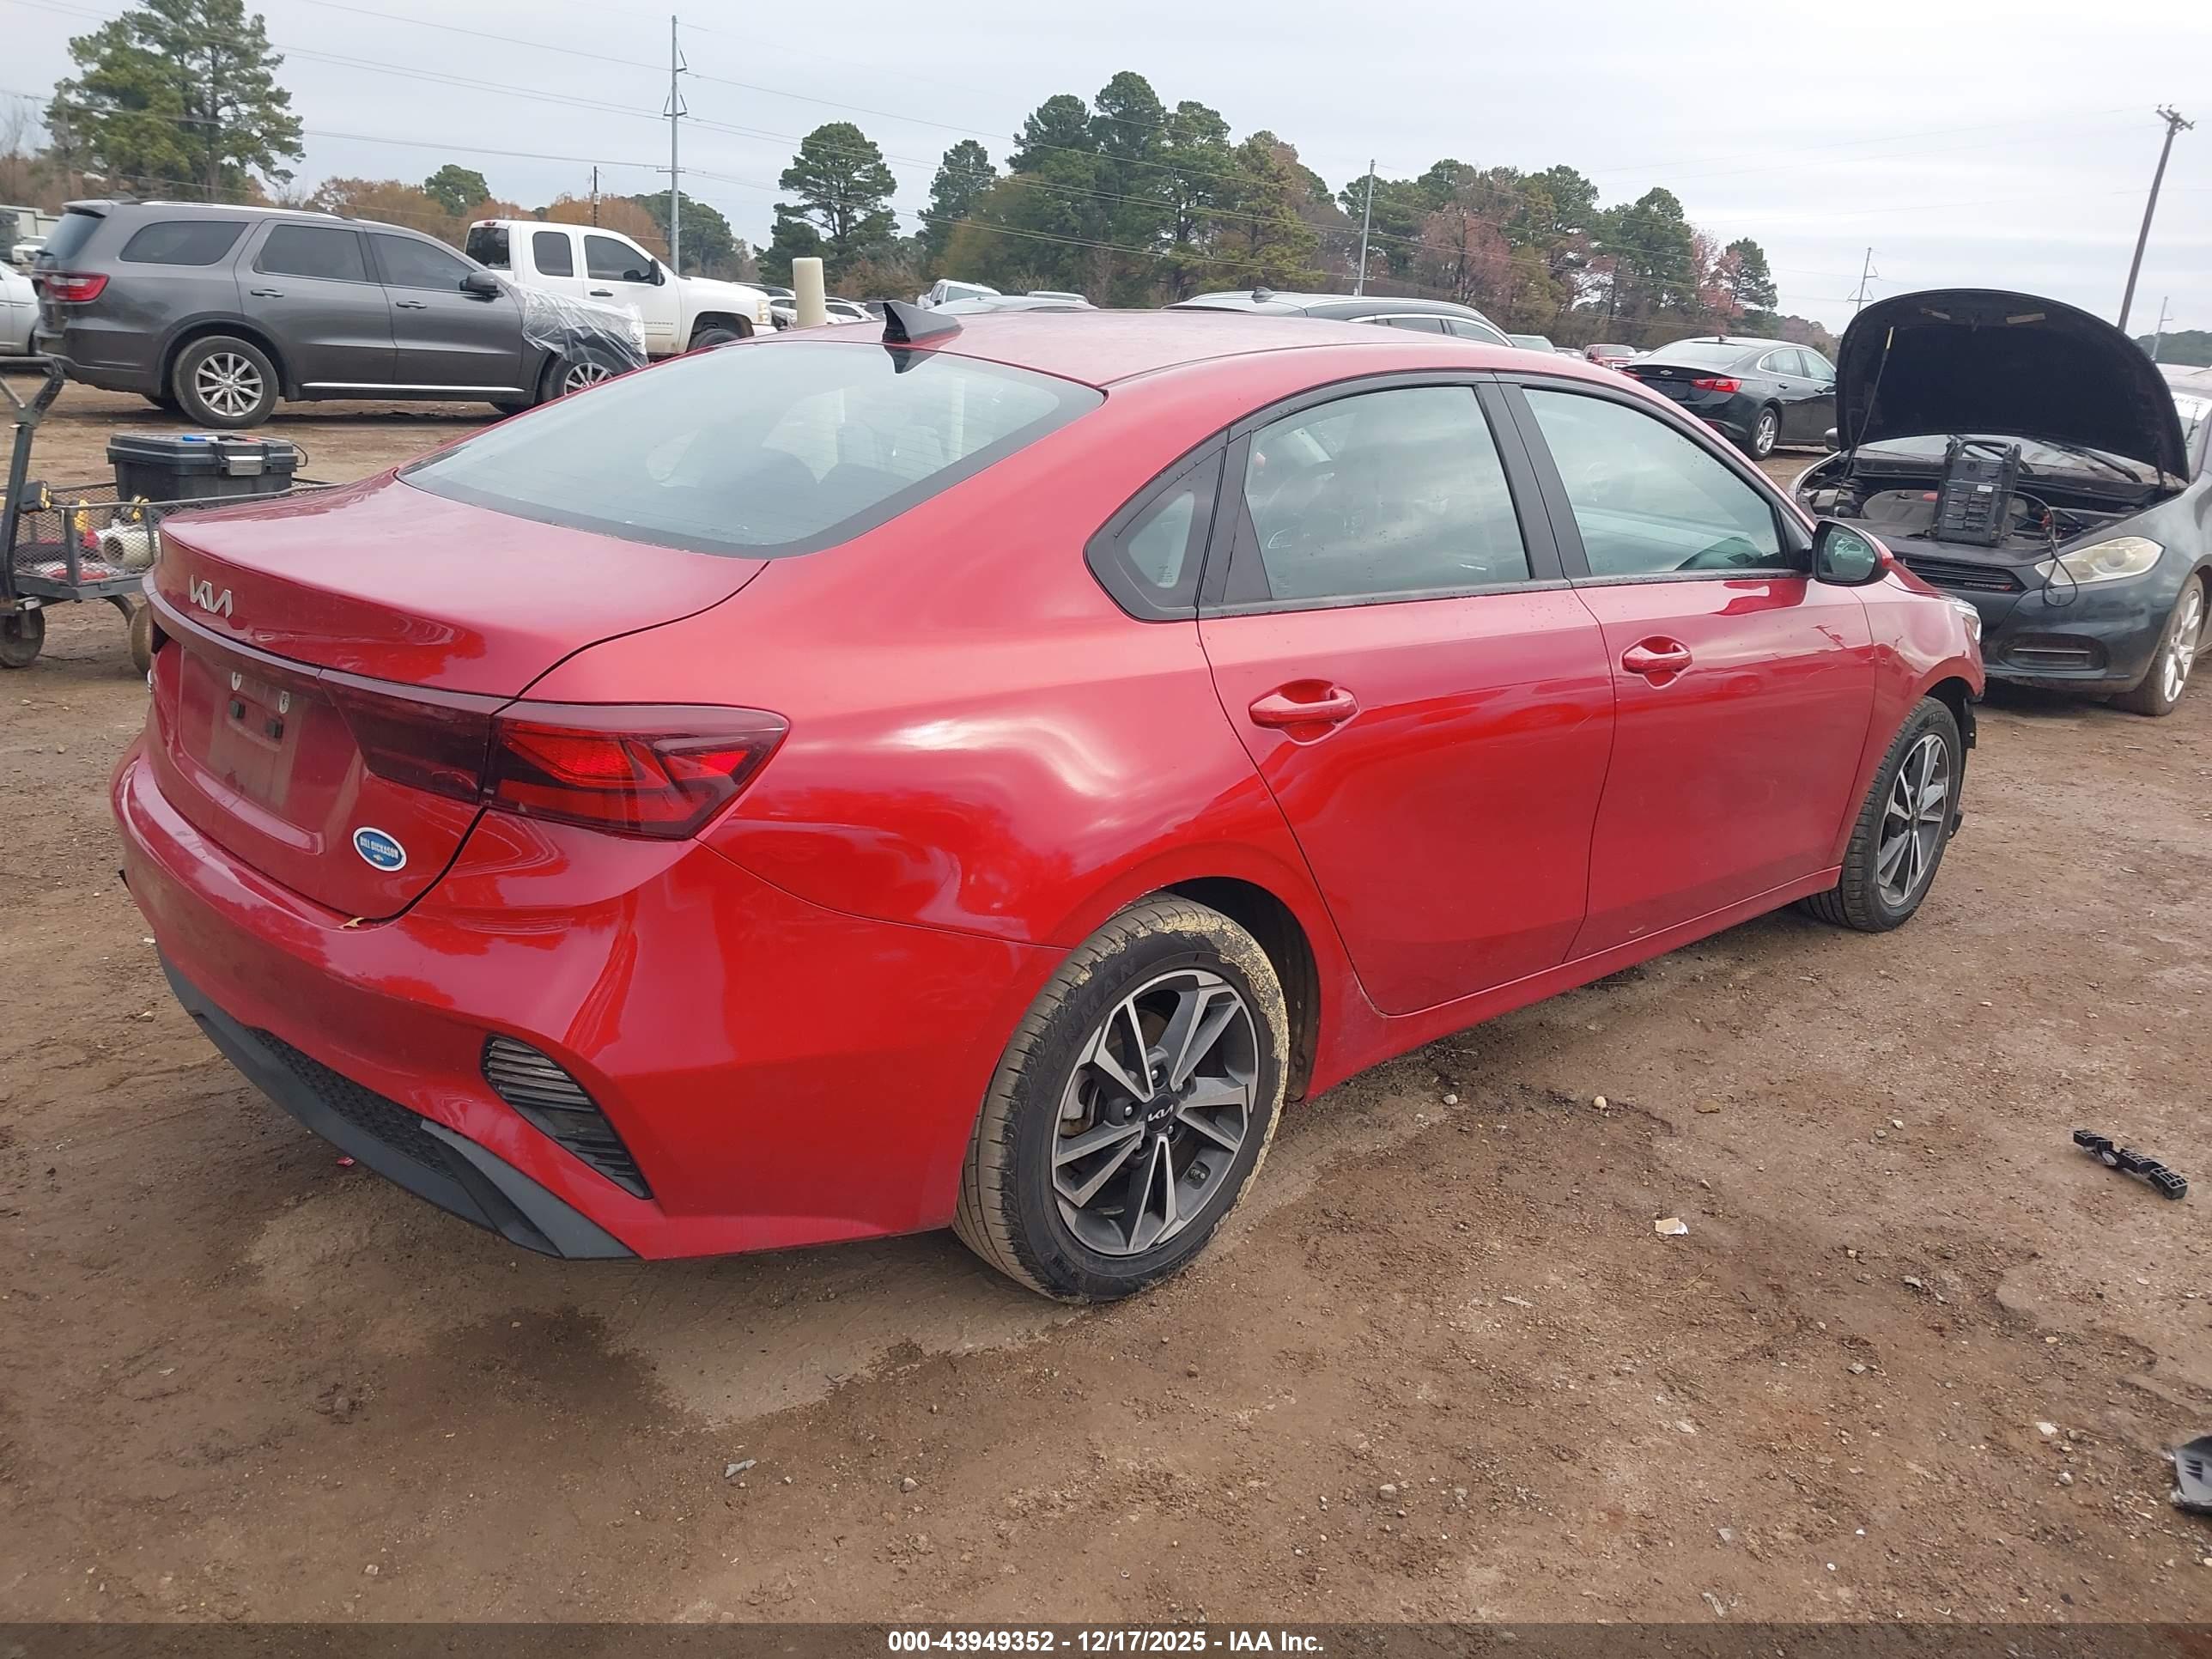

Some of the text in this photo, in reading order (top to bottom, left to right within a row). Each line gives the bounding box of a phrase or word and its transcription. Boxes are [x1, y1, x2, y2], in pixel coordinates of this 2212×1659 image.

[190, 574, 234, 619] KIA
[360, 836, 370, 848] BILL
[1147, 1104, 1174, 1121] KIA
